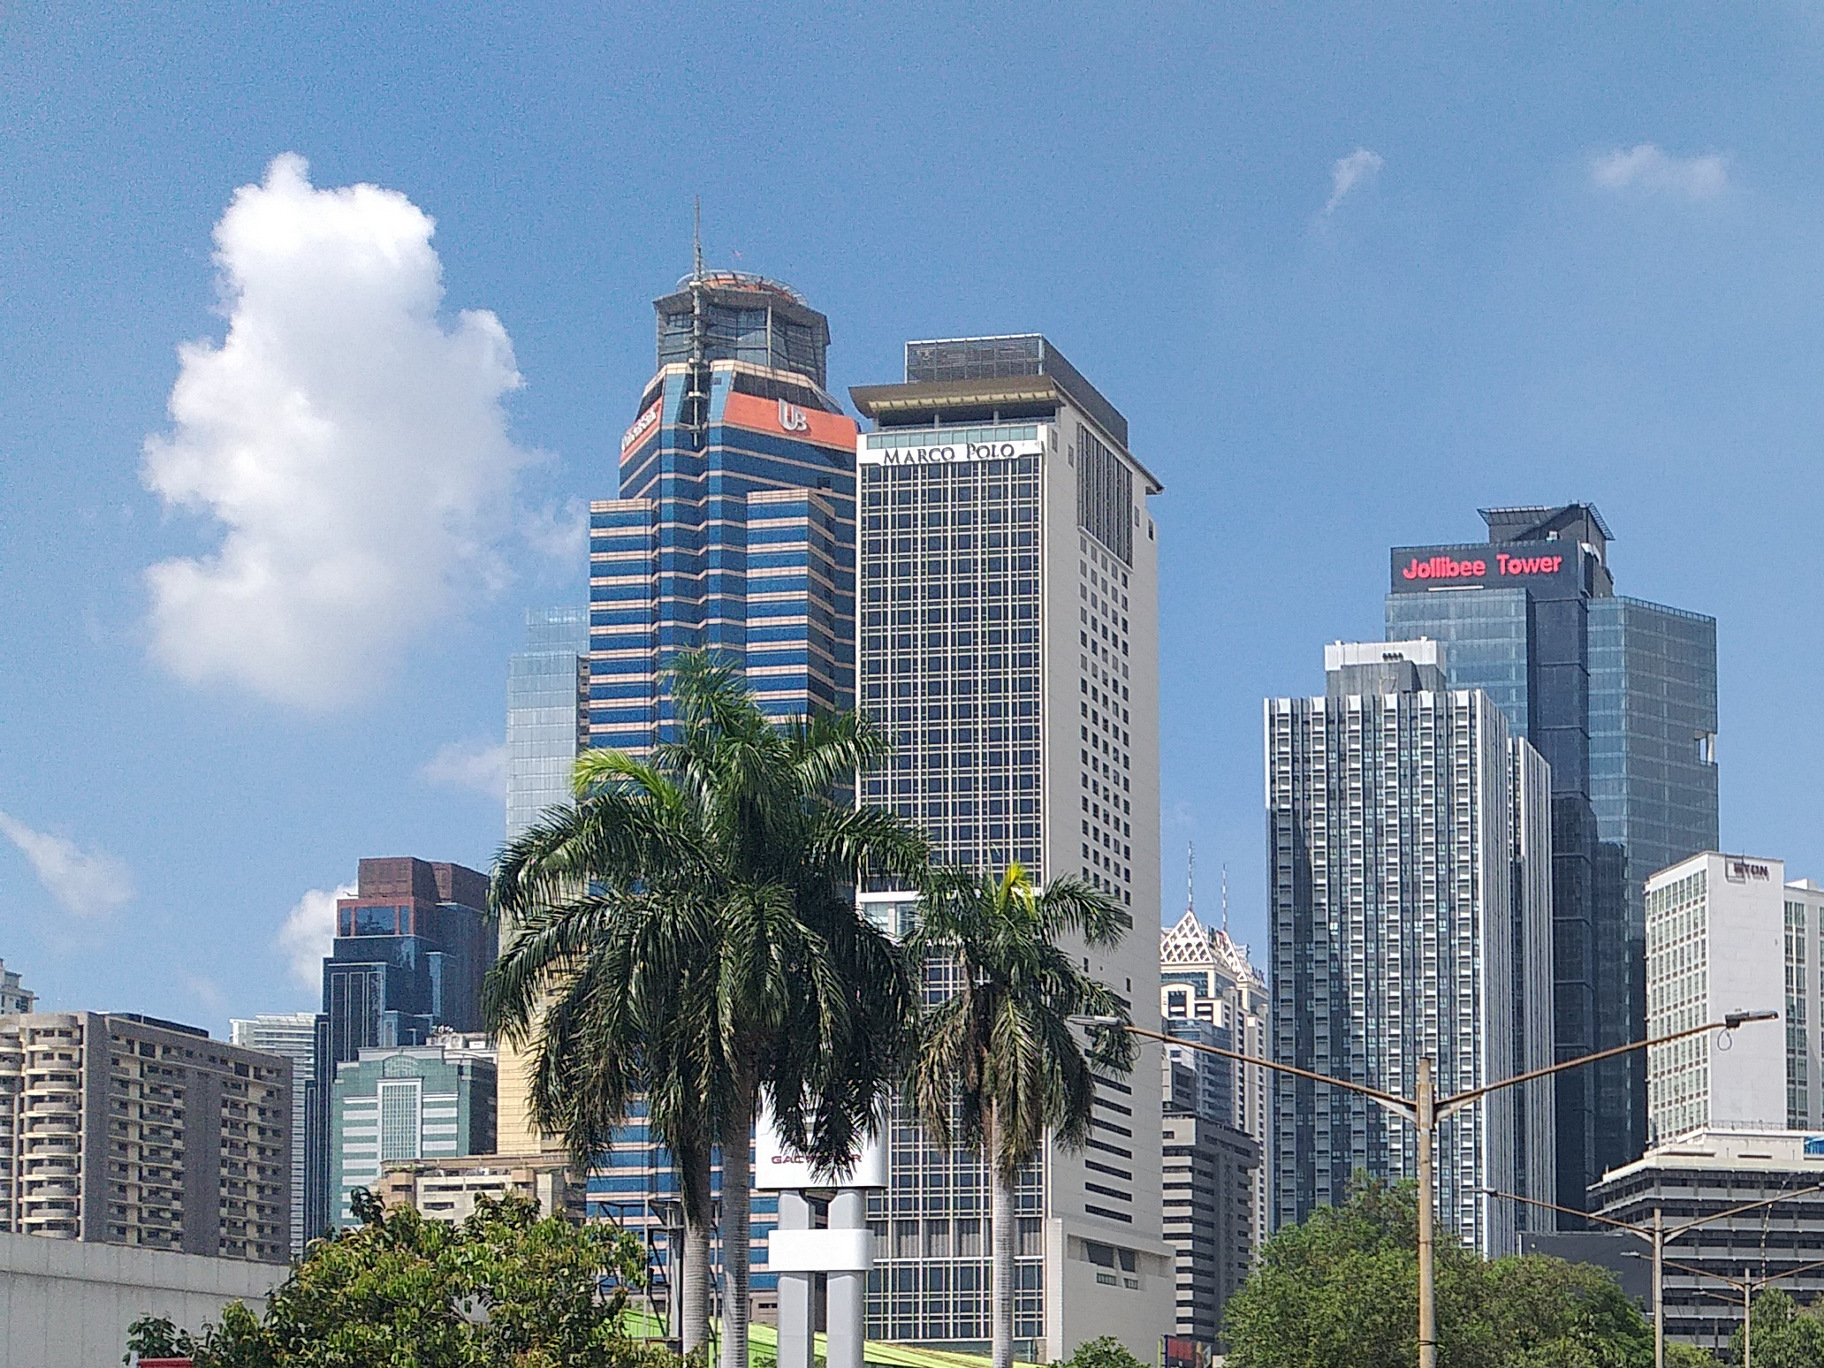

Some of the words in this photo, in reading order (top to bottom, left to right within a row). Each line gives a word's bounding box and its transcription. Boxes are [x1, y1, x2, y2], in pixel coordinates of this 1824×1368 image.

[884, 447, 955, 464] MARCO
[967, 443, 1015, 460] POLO
[1402, 556, 1486, 580] Jollibee
[1496, 553, 1562, 576] Tower
